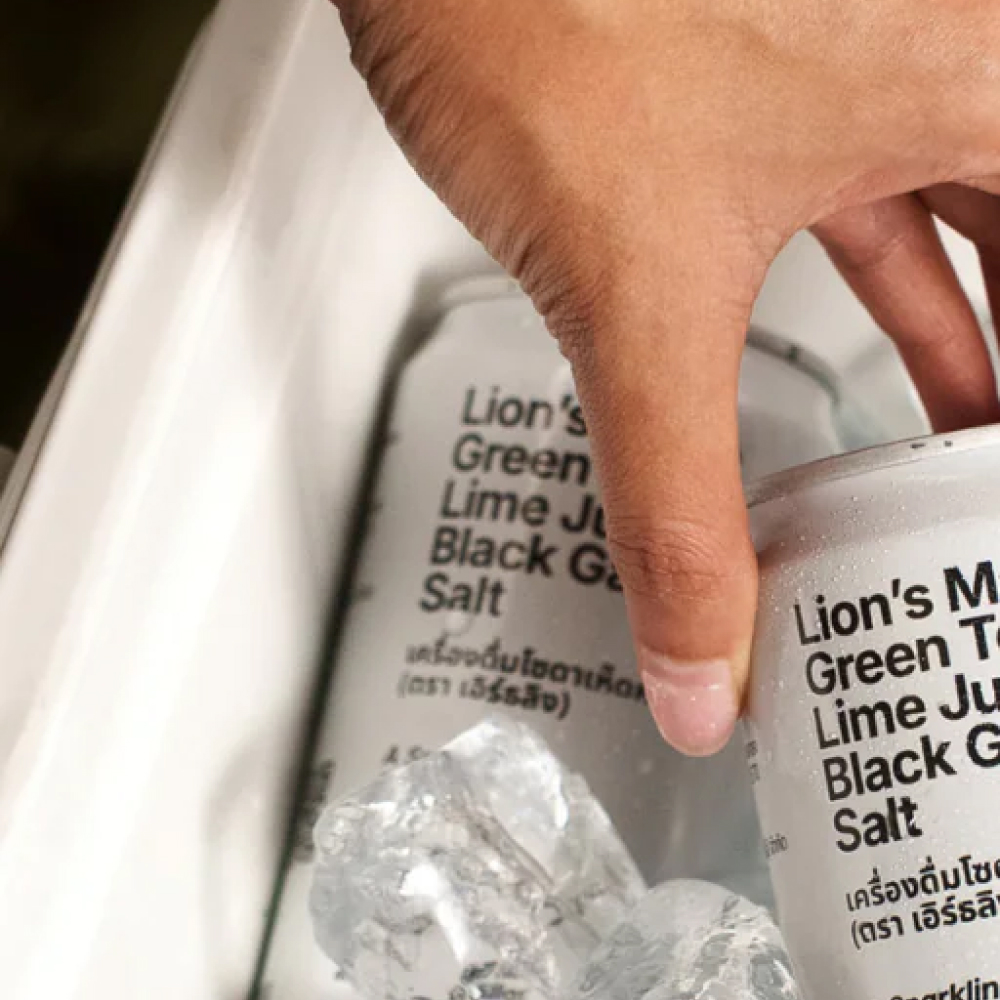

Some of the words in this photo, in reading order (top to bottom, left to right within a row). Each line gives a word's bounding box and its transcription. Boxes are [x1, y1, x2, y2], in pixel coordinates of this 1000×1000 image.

[461, 388, 587, 437] Lion's
[452, 434, 590, 486] Green
[439, 480, 550, 525] Lime
[429, 527, 557, 576] Black
[419, 573, 507, 617] Salt
[793, 578, 934, 646] Lion's
[405, 634, 646, 702] เครื่องดื่มโซดาเห็ด
[805, 633, 951, 696] Green
[813, 694, 927, 750] Lime
[822, 734, 957, 802] Black
[833, 796, 923, 853] Salt
[850, 912, 904, 950] (ตรา
